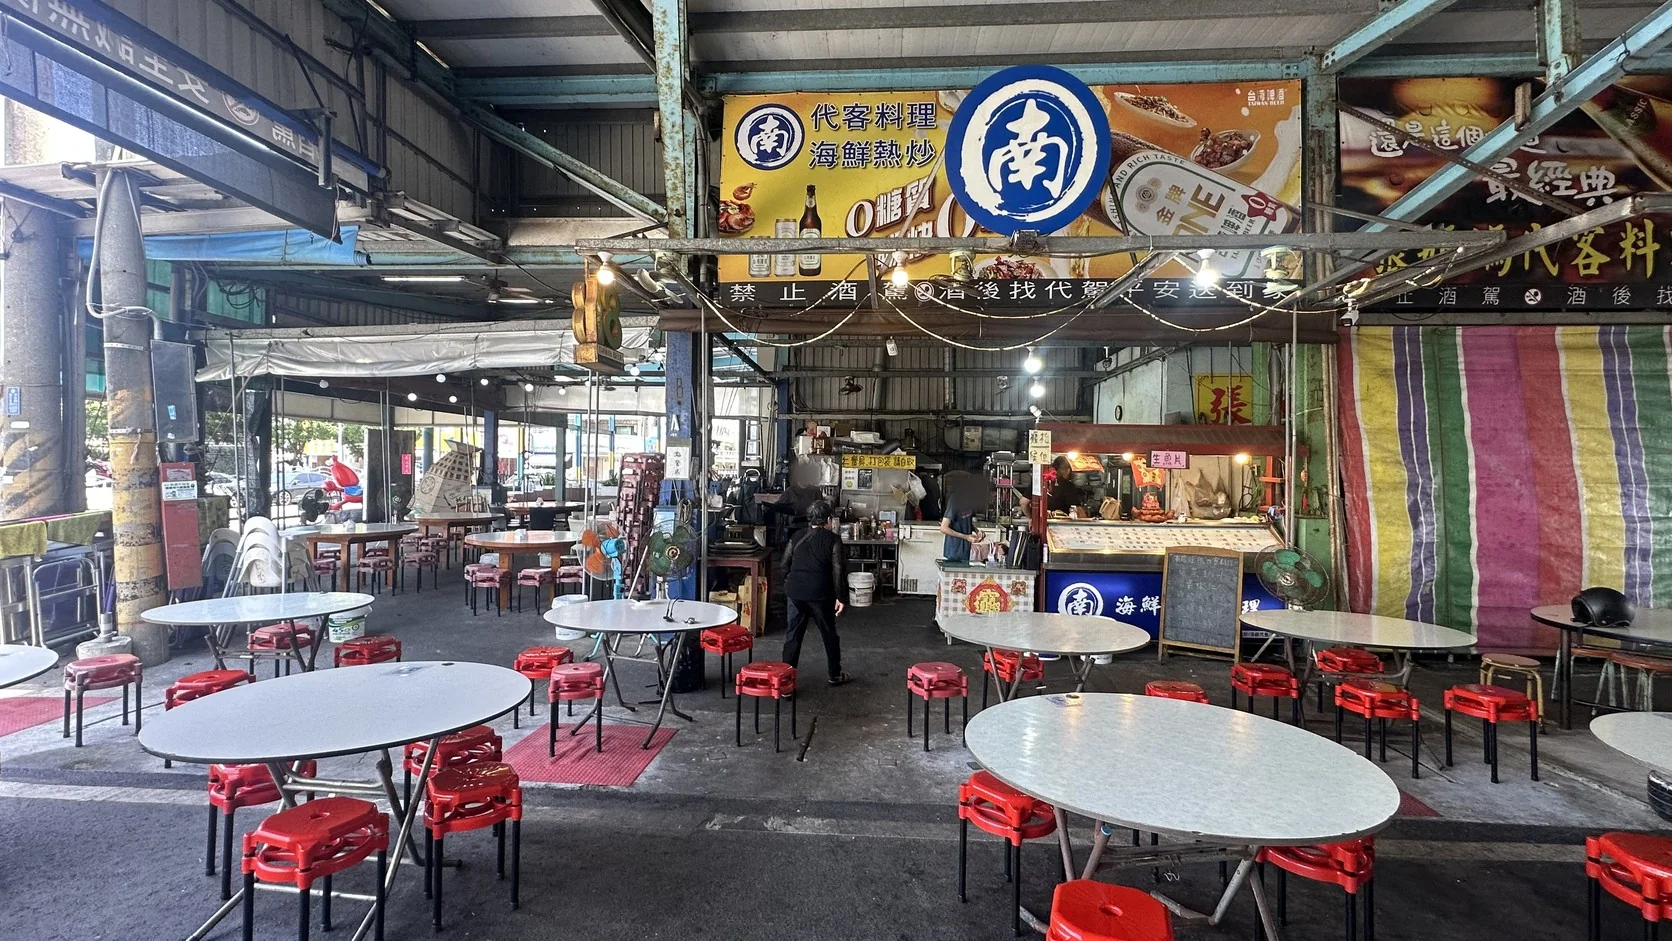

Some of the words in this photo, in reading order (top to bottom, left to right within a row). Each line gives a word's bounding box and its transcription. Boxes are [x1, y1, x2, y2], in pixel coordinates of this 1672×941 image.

[811, 102, 937, 130] 代客料理
[808, 139, 936, 168] 海鮮熱炒
[986, 99, 1069, 198] 南
[1114, 169, 1128, 189] AND
[1127, 154, 1150, 170] RICH
[1154, 153, 1185, 165] TASTE
[1156, 184, 1187, 226] 金牌
[729, 283, 908, 302] 禁止酒駕
[1210, 385, 1252, 425] 張
[1152, 452, 1182, 466] 生魚片
